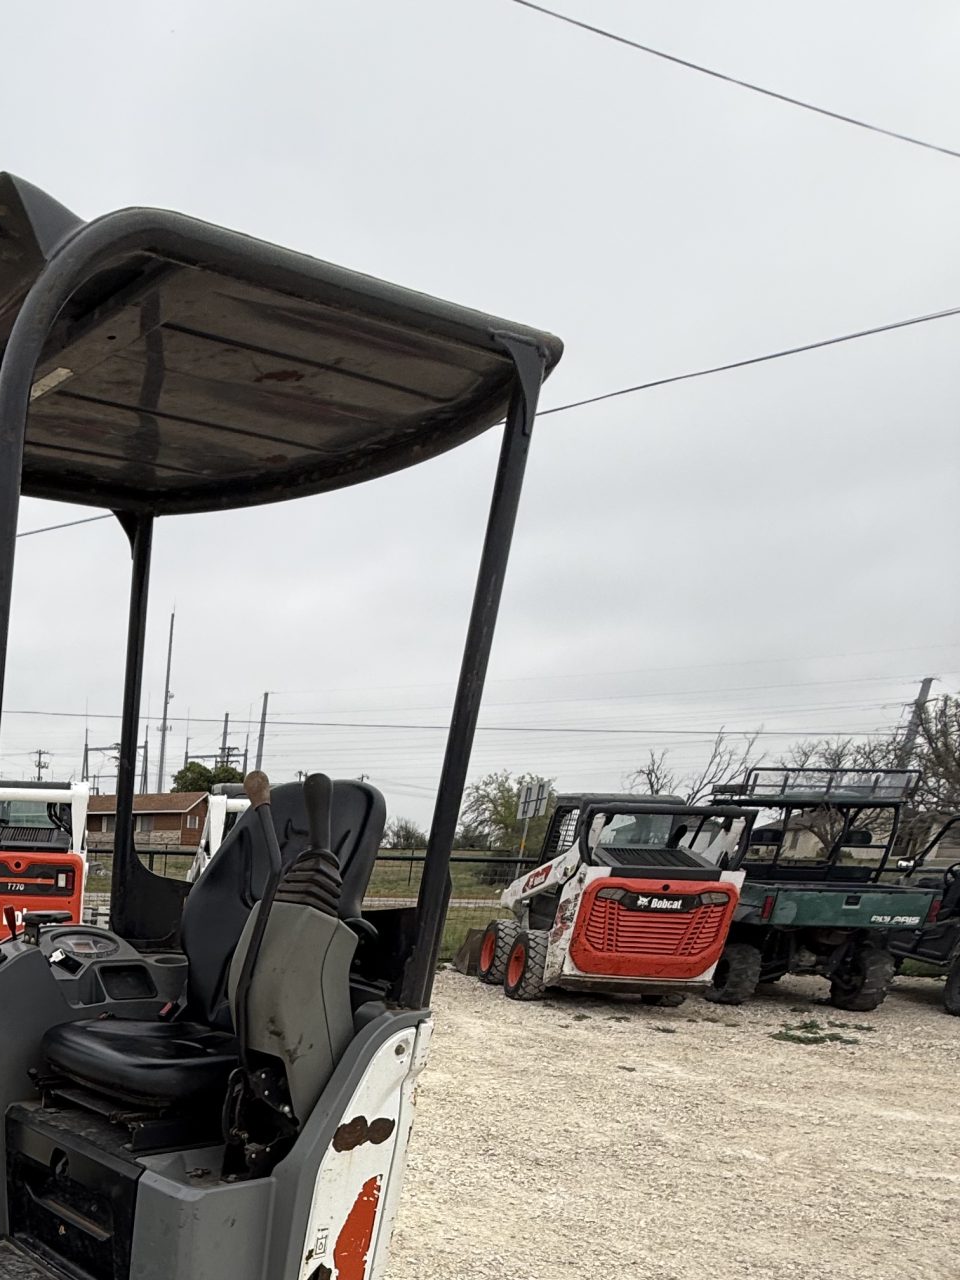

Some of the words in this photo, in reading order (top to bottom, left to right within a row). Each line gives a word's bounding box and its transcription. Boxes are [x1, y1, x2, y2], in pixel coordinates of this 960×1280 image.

[7, 883, 25, 891] T770
[651, 898, 682, 909] Bobcat
[871, 915, 920, 925] POLARIS
